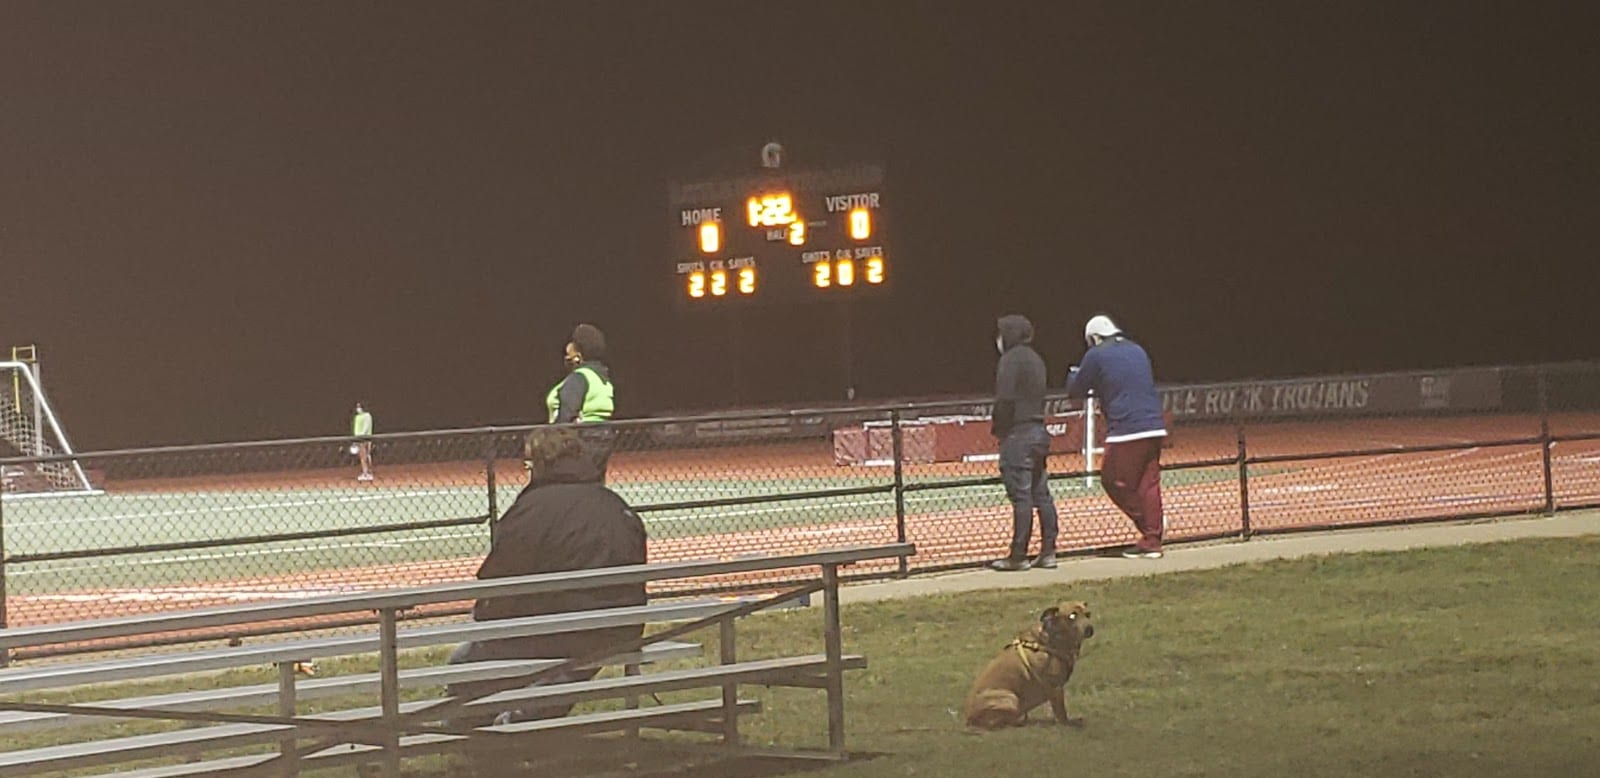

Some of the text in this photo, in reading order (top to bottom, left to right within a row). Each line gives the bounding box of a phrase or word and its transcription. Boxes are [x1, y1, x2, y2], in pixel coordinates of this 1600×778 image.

[825, 193, 880, 213] VISITOR
[681, 207, 722, 227] HOME
[789, 219, 805, 246] 2
[728, 256, 755, 270] SAVES
[855, 246, 882, 259] SAVES
[711, 270, 726, 296] 2
[739, 267, 756, 294] 2
[815, 262, 831, 288] 2
[867, 257, 883, 284] 2
[688, 272, 705, 298] 2
[1271, 380, 1370, 411] TROJANS
